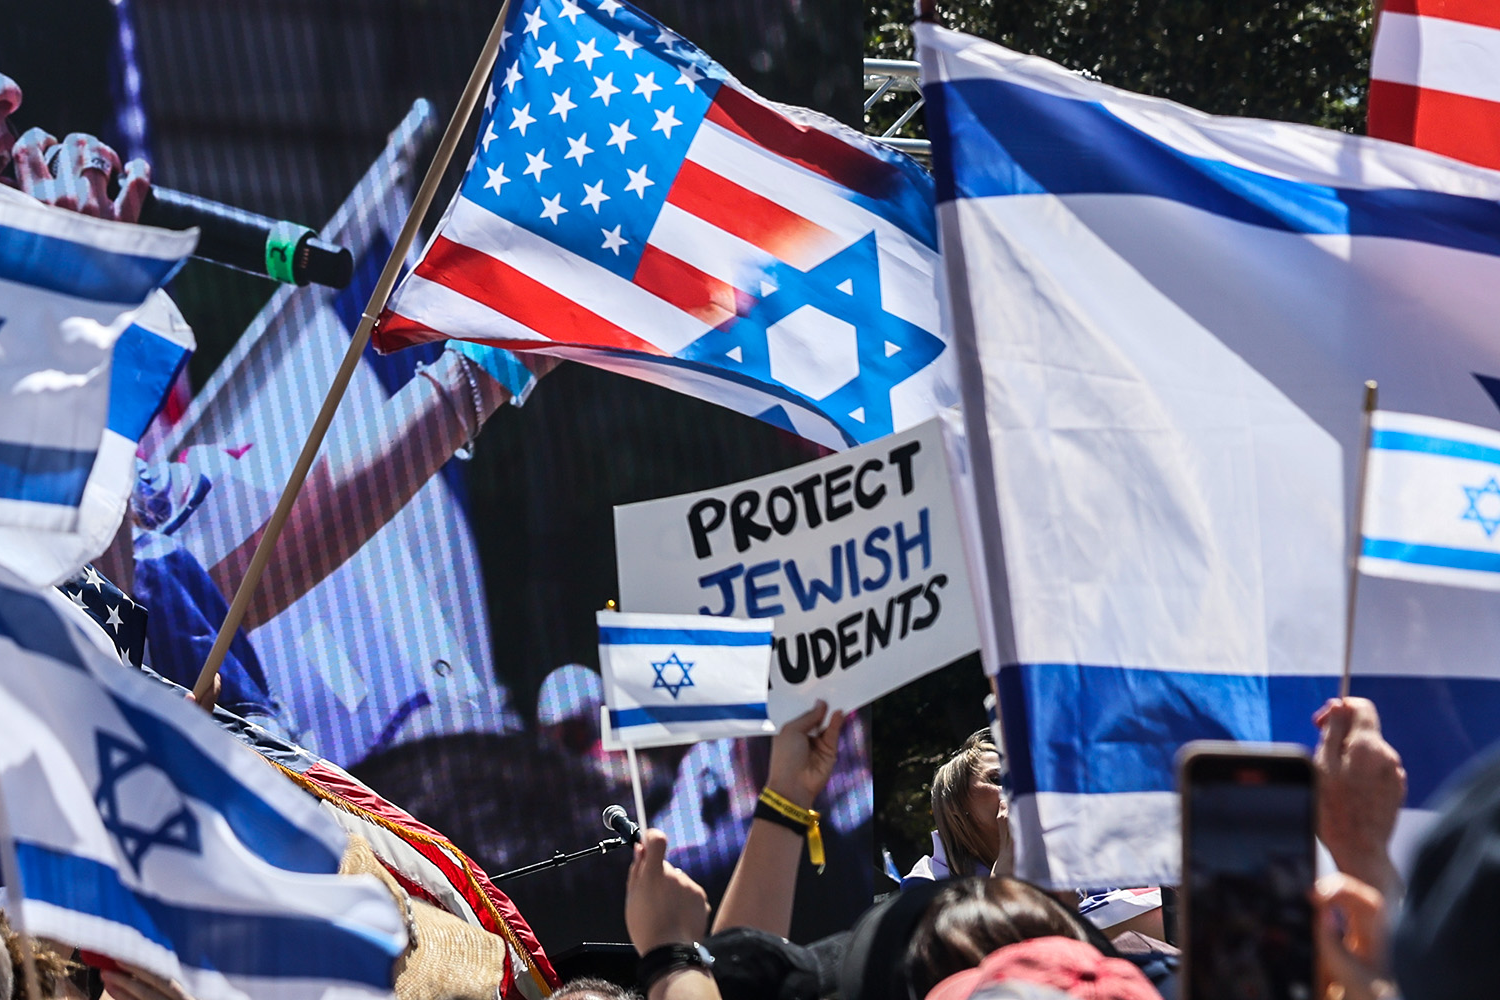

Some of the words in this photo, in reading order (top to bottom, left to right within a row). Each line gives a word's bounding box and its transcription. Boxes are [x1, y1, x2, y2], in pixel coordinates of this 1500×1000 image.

[687, 440, 921, 559] PROTECT
[698, 507, 931, 618] JEWISH
[767, 573, 948, 690] UDENTS
